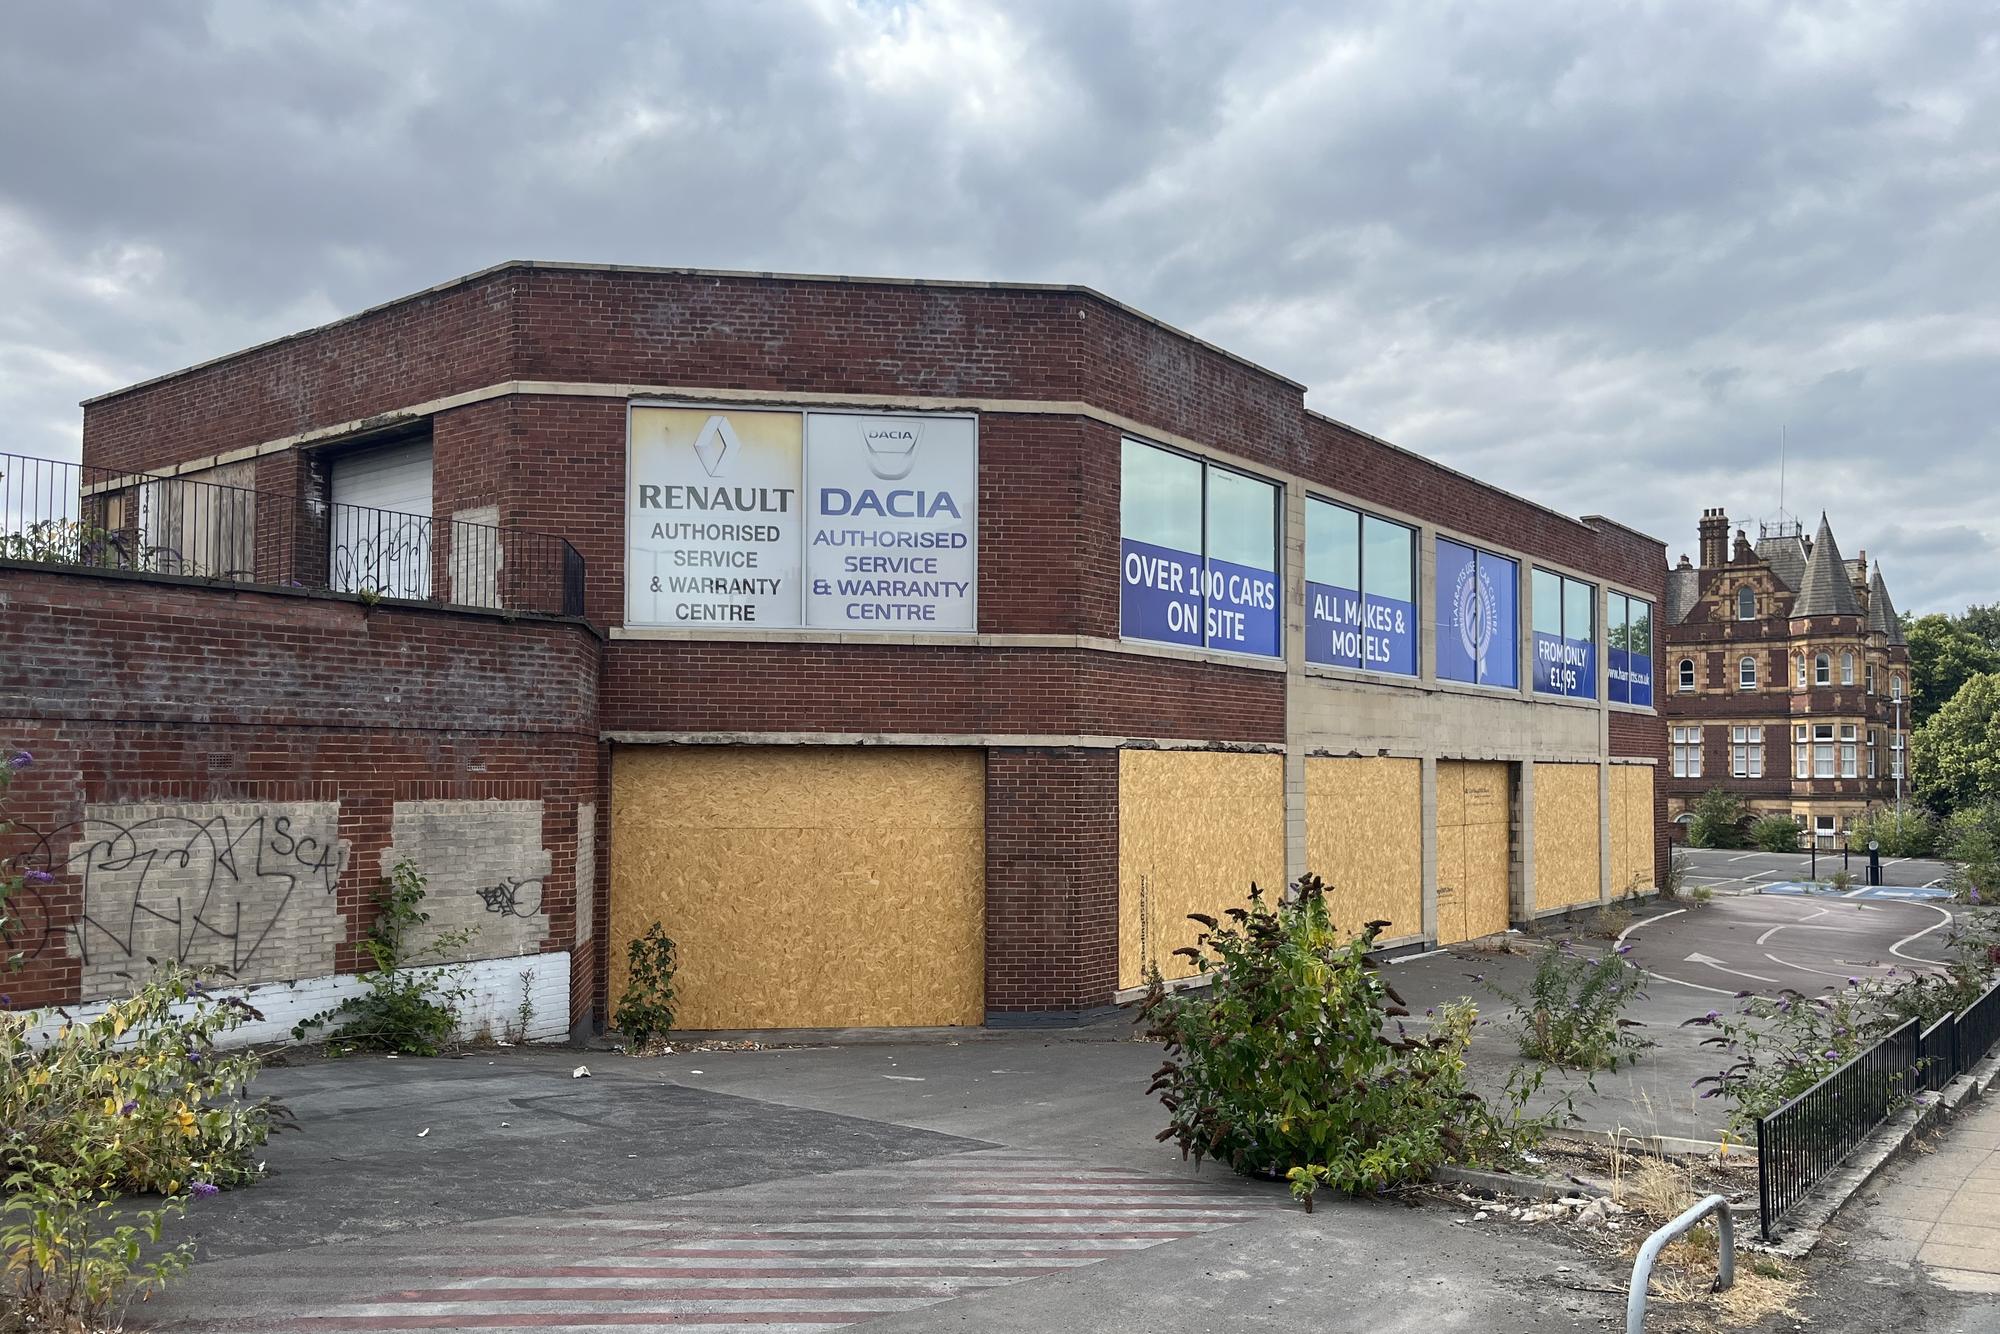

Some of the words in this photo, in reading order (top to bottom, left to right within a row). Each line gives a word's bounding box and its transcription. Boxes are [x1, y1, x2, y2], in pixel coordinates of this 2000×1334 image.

[868, 431, 913, 440] DACIA
[639, 484, 795, 513] RENAULT
[820, 487, 962, 519] DACIA
[651, 523, 781, 543] AUTHORISED
[812, 529, 967, 549] AUTHORISED
[673, 550, 758, 569] SERVICE
[844, 556, 938, 574] SERVICE
[649, 576, 663, 593] &
[668, 576, 782, 596] WARRANTY
[812, 579, 832, 596] &
[837, 579, 969, 598] WARRANTY
[1125, 552, 1184, 594] OVER
[1189, 566, 1225, 601] 100
[1228, 574, 1275, 610] CARS
[675, 603, 756, 622] CENTRE
[846, 603, 936, 621] CENTRE
[1167, 601, 1198, 635] ON
[1208, 607, 1245, 641] SITE
[1313, 593, 1342, 623] ALL
[1394, 609, 1405, 634] &
[1538, 639, 1564, 663] FROM
[1565, 645, 1586, 667] ONLY
